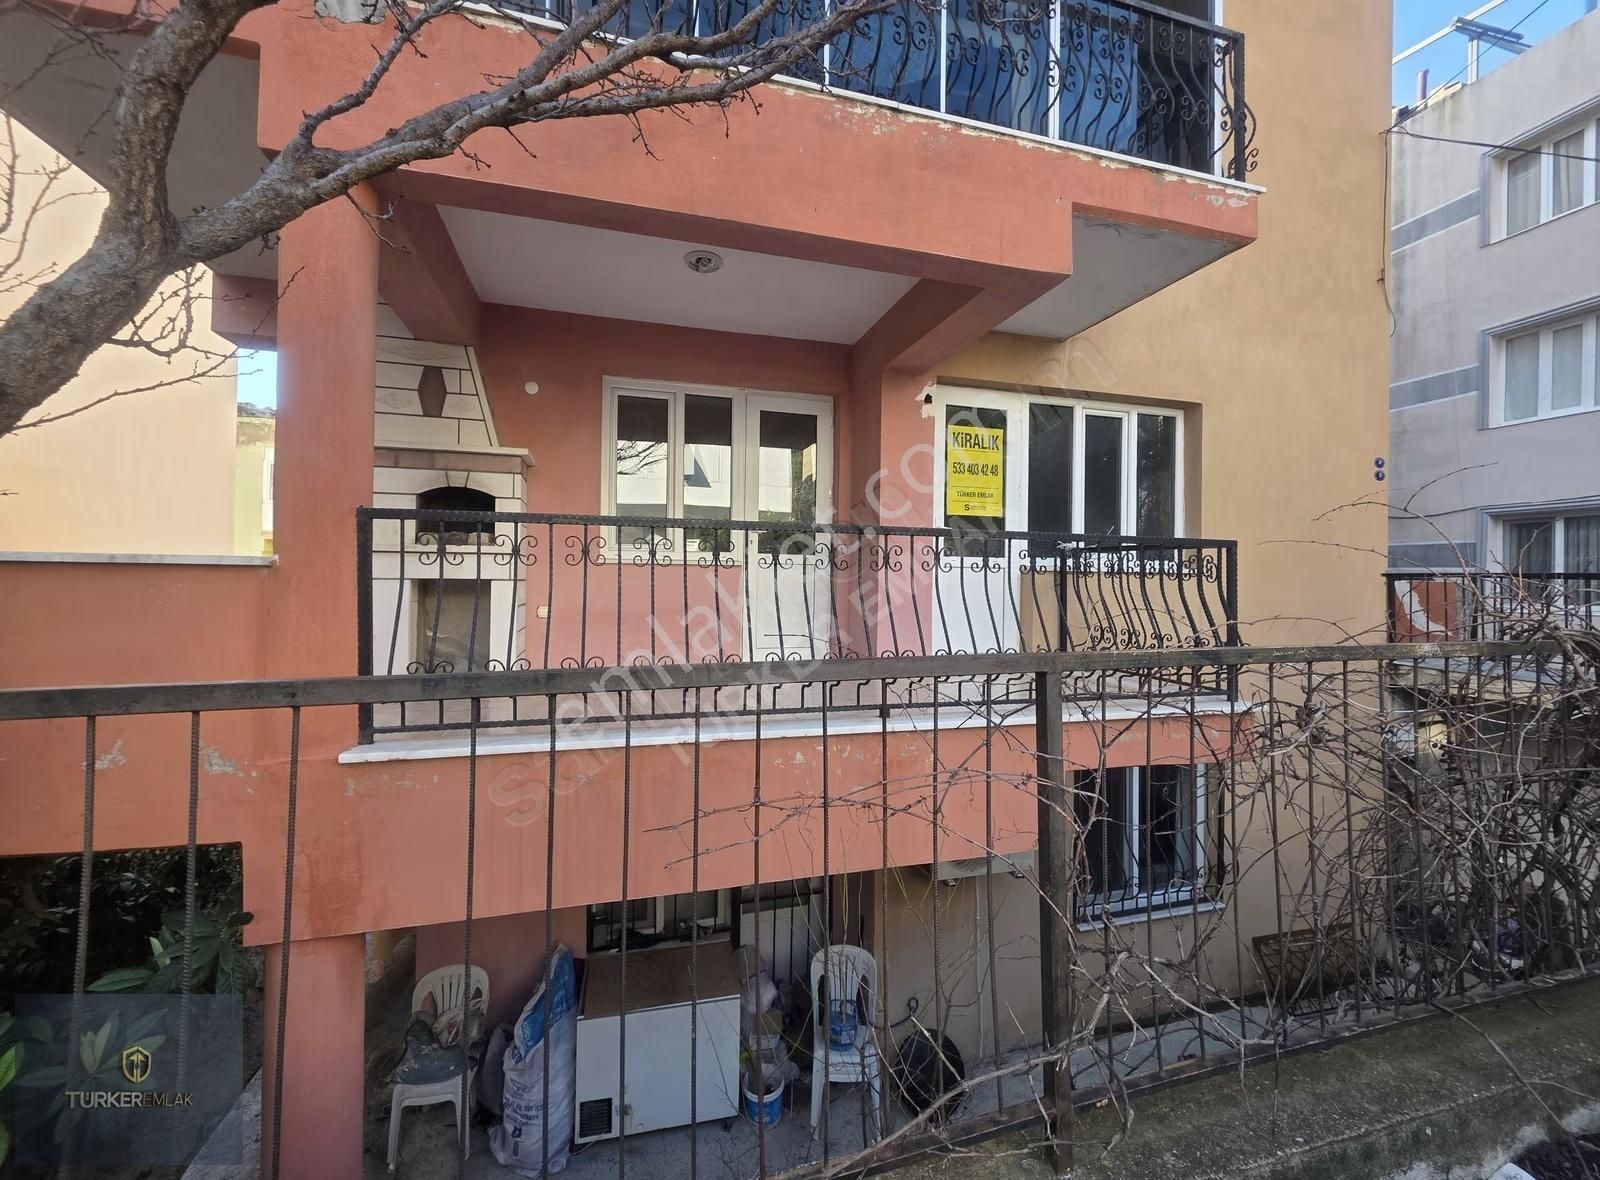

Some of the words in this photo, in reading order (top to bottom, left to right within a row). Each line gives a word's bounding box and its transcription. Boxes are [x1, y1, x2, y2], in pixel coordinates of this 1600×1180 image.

[952, 461, 966, 475] 533
[966, 463, 980, 476] 403
[980, 463, 989, 476] 42
[989, 464, 999, 477] 48
[956, 489, 976, 498] TÜRKER
